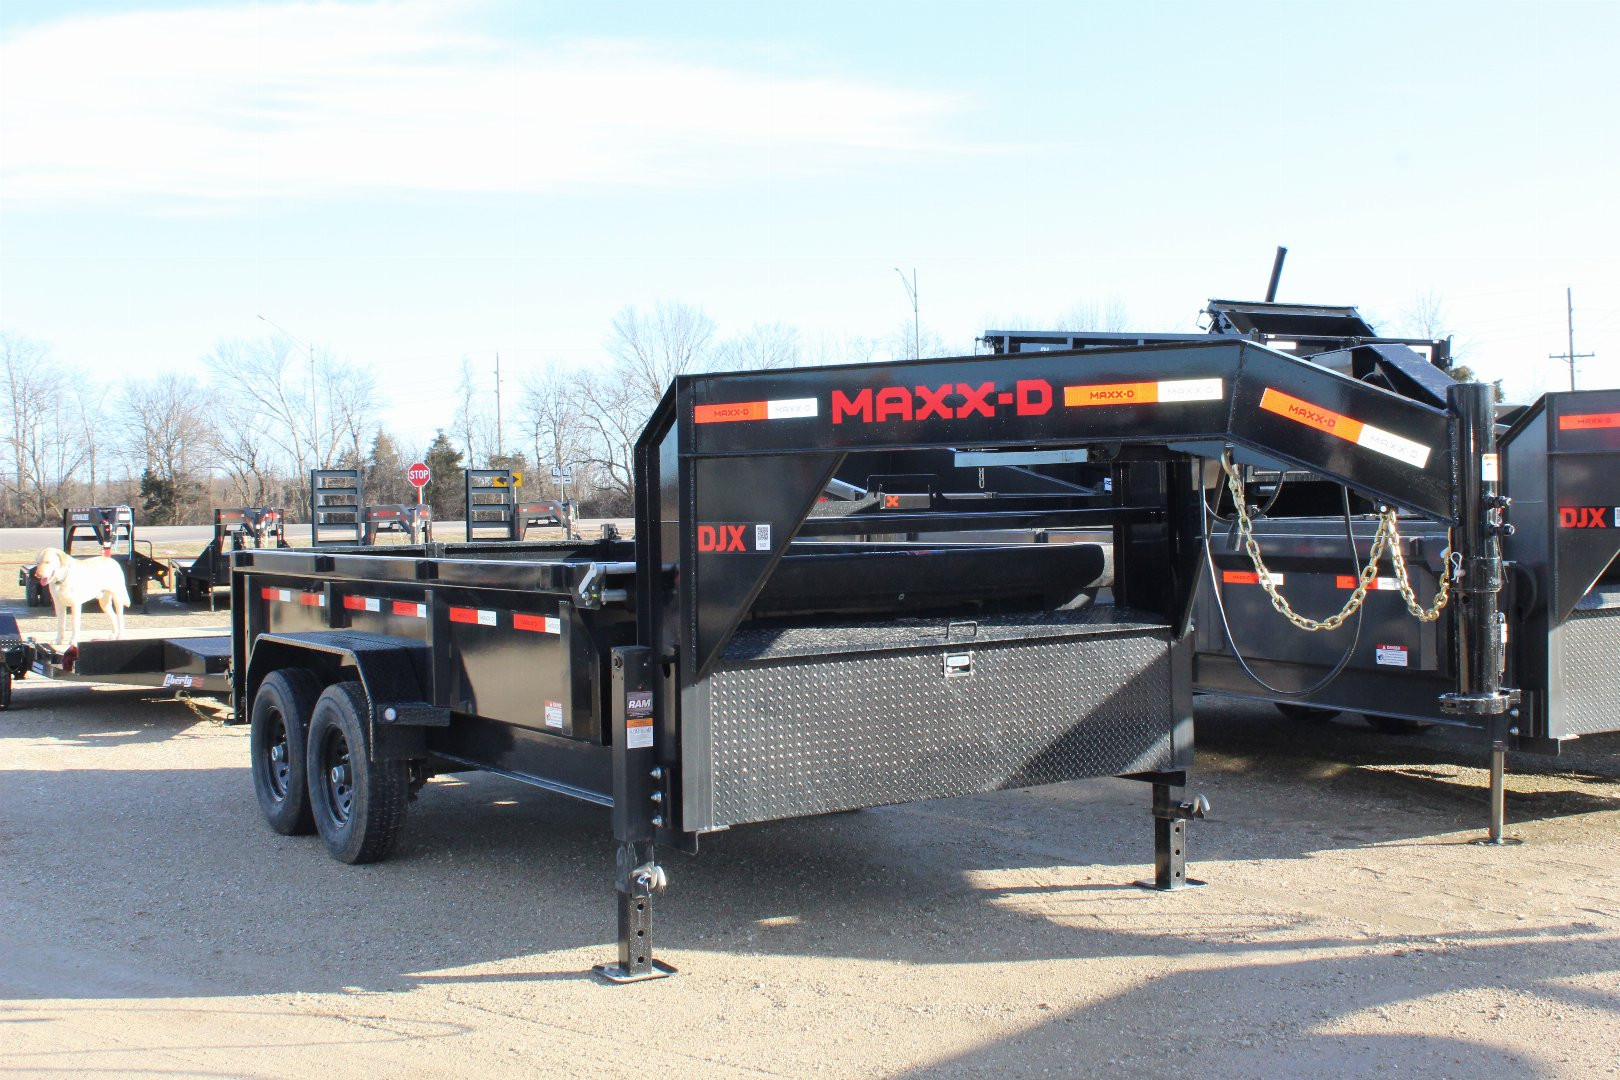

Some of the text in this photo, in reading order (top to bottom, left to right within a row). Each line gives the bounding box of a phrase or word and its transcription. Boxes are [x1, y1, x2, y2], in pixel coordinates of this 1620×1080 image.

[832, 378, 1053, 424] MAXX-D
[1089, 389, 1135, 400] MAXX-D
[713, 408, 750, 418] MAXX-D
[1288, 404, 1336, 428] MAXX-D
[409, 469, 429, 480] STOP
[1559, 507, 1607, 528] DJX
[697, 525, 747, 552] DJX
[162, 673, 193, 688] Liberty
[628, 699, 651, 709] RAM
